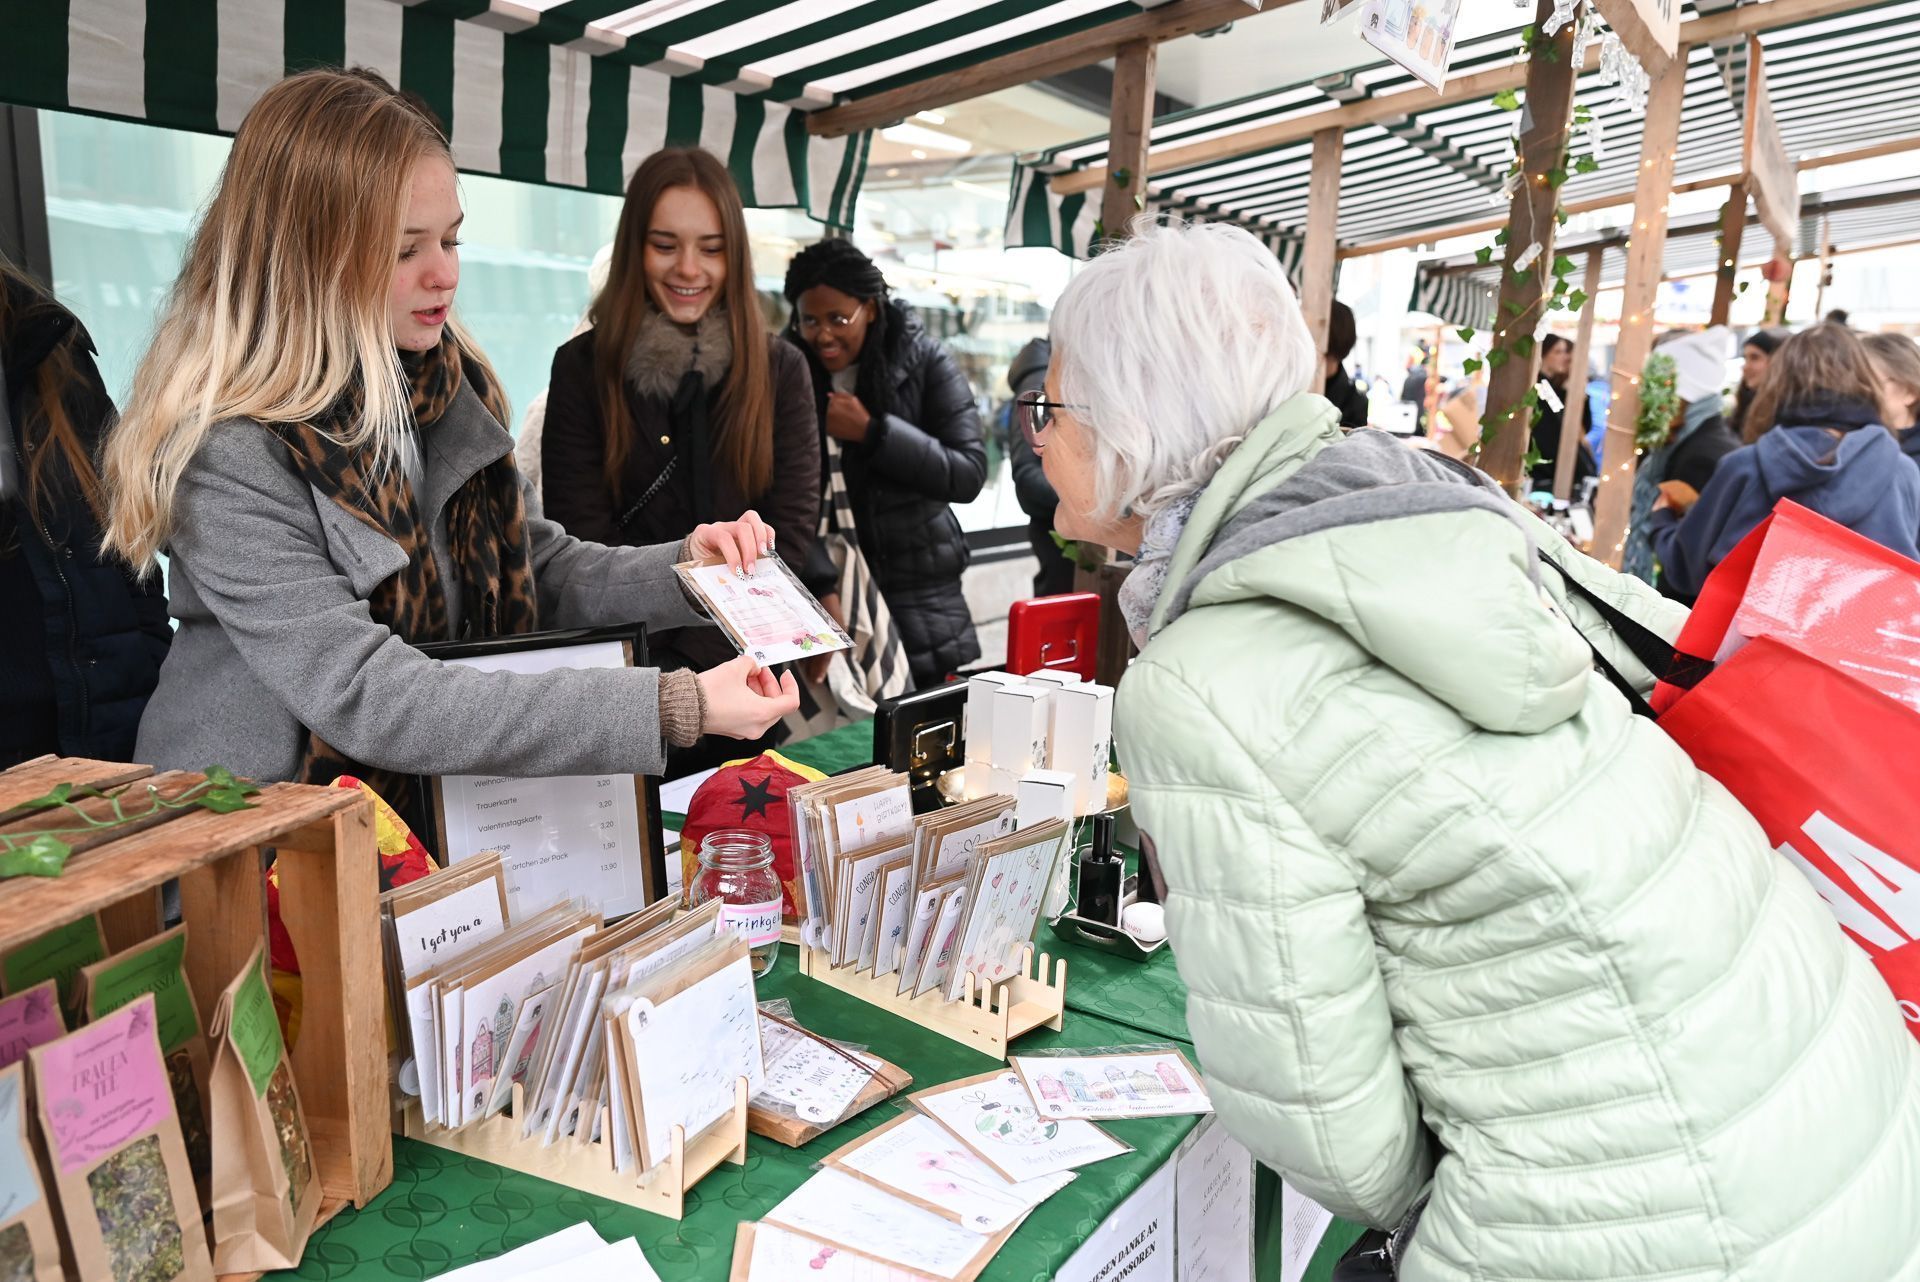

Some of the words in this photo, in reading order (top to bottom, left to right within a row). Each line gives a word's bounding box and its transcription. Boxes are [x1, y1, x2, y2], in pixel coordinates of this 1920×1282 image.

[597, 779, 611, 788] 3,20
[476, 797, 518, 811] Trauerkarte
[598, 800, 613, 809] 3,20
[873, 796, 893, 811] HAPPY
[478, 814, 543, 833] Valentinstagskarte
[600, 821, 614, 830] 3,20
[602, 842, 616, 850] 1,90
[551, 853, 569, 862] Pack
[600, 862, 618, 872] 13,90
[420, 937, 427, 951] I
[429, 928, 447, 954] got
[449, 924, 472, 944] you
[473, 917, 483, 927] a
[1118, 1229, 1146, 1263] DANKE
[1146, 1217, 1158, 1237] AN
